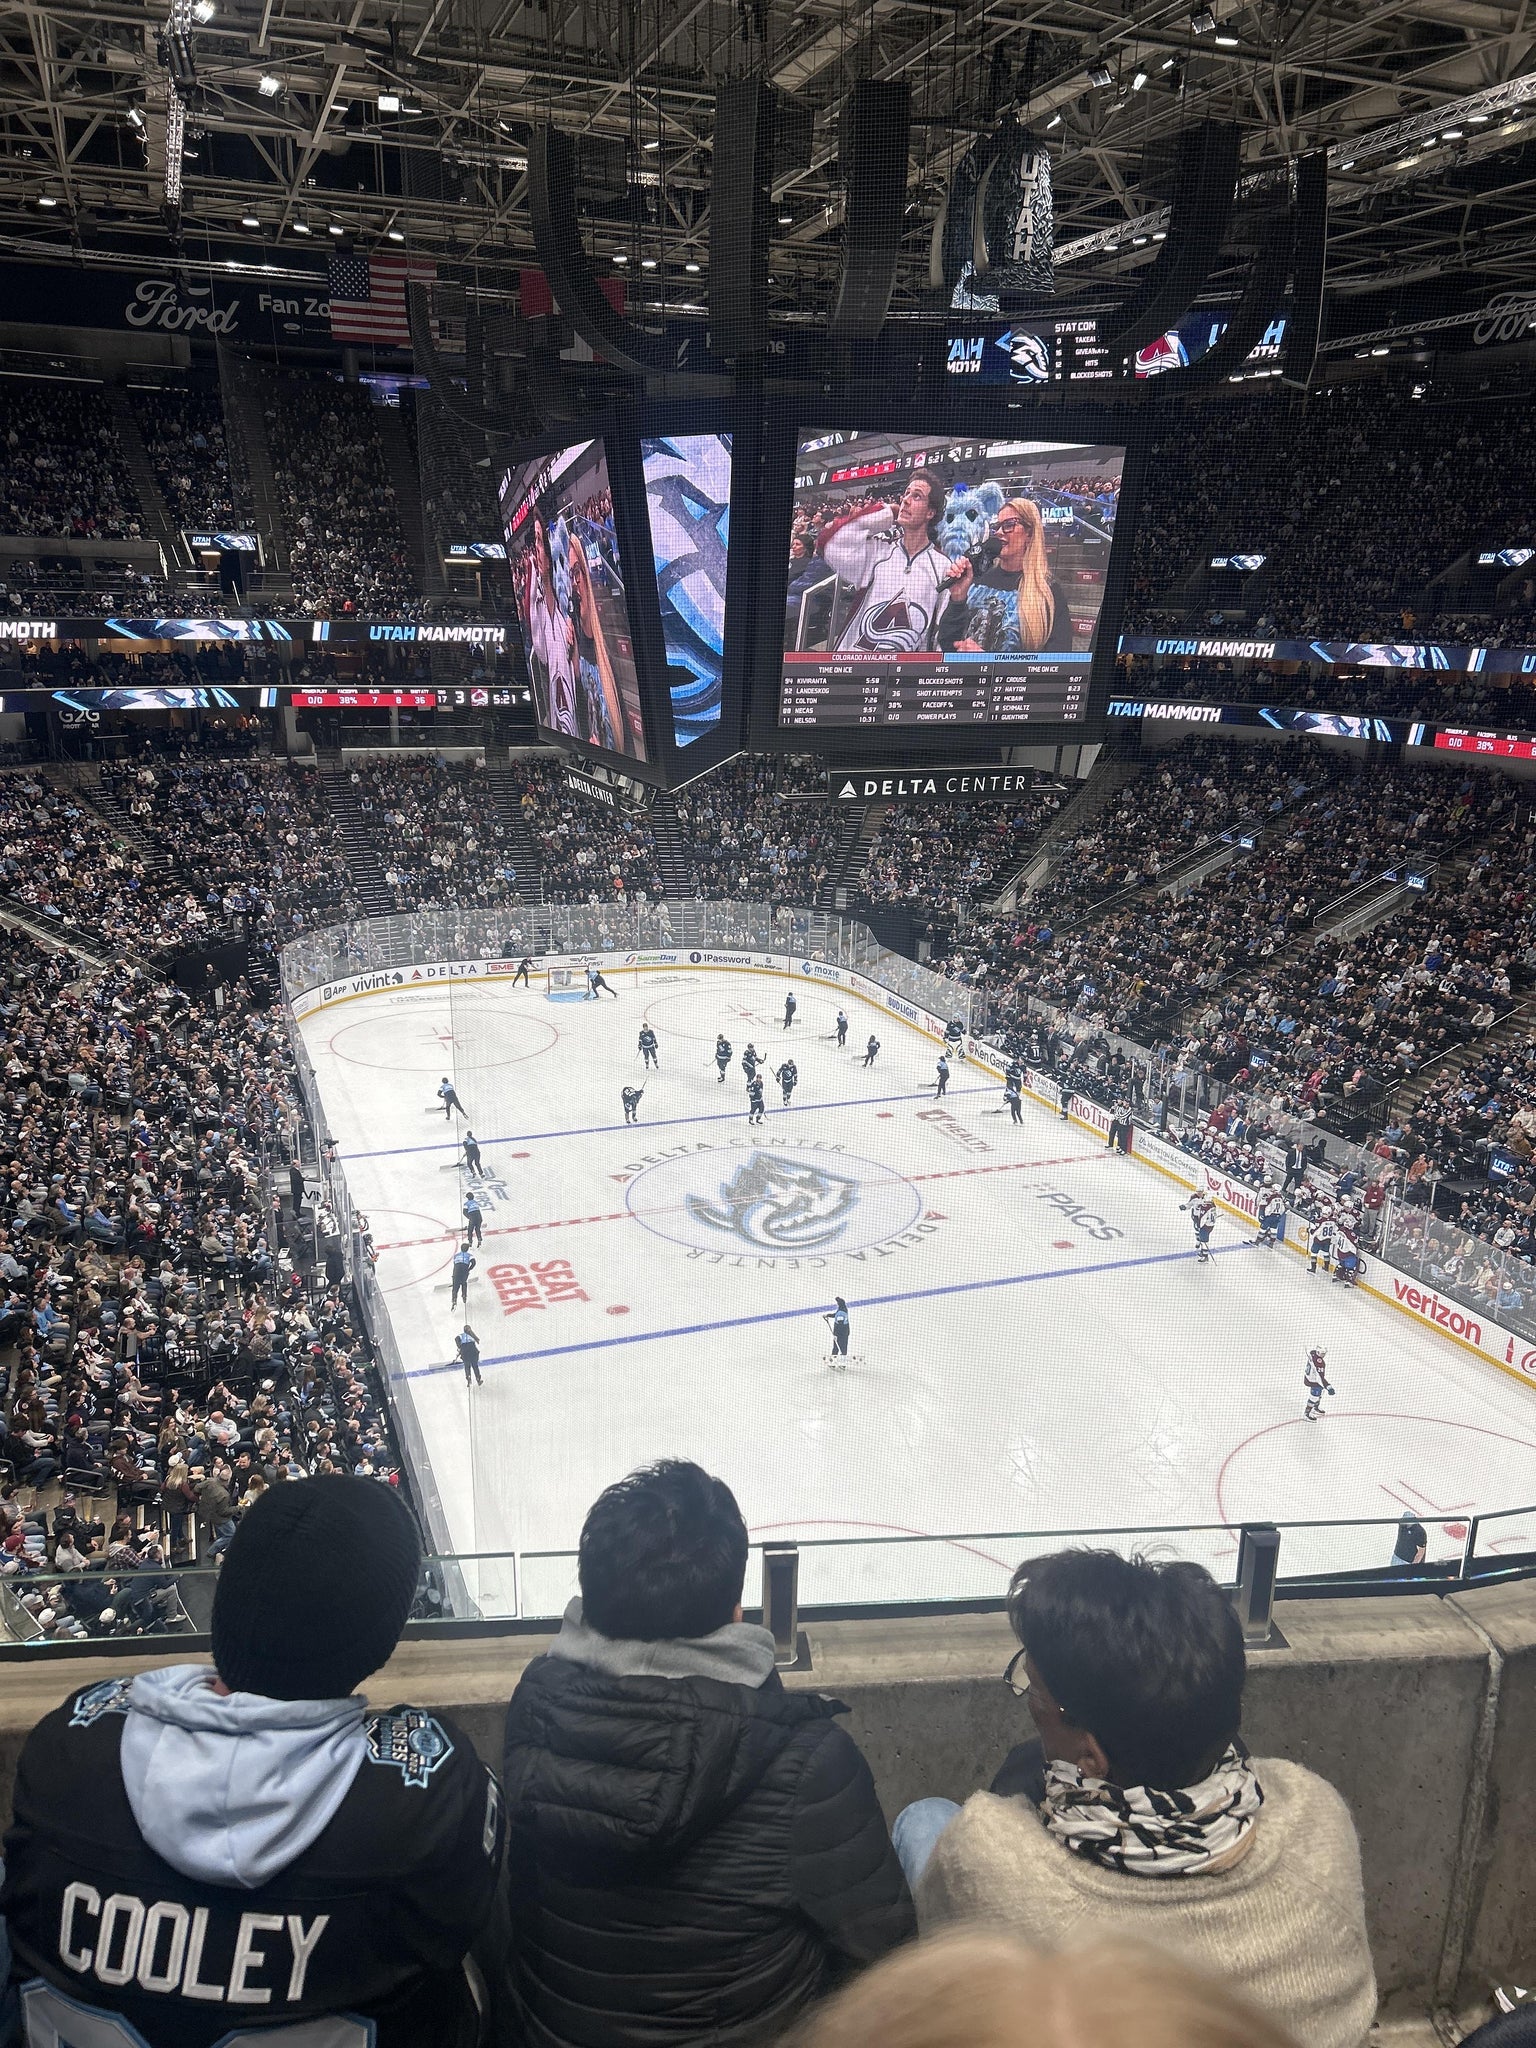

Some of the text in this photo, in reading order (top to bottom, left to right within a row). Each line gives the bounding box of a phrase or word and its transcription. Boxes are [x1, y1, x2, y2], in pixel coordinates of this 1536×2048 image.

[1013, 153, 1041, 261] UTAH
[125, 280, 240, 333] Ford
[259, 294, 299, 316] Fan
[1055, 322, 1075, 333] STAT
[0, 622, 56, 638] MOTH
[370, 626, 506, 642] UTAH MAMMOTH
[1156, 640, 1275, 658] UTAH MAMMOTH
[1521, 655, 1536, 673] U
[339, 695, 358, 704] 38%
[372, 696, 377, 704] 7
[415, 696, 425, 704] 36
[437, 695, 448, 703] 17
[455, 691, 465, 704] 3
[493, 694, 516, 704] 5:21
[1143, 703, 1221, 722] MAMMOTH
[1448, 737, 1462, 748] 0/0
[1477, 740, 1494, 751] 38%
[1508, 744, 1514, 754] 7
[573, 776, 615, 807] DELTA CENTER
[864, 775, 1026, 796] DELTA CENTER
[490, 963, 515, 972] SME
[703, 953, 751, 965] 1Password
[427, 965, 478, 977] DELTA
[814, 966, 840, 979] moxie
[352, 972, 391, 993] vivint
[888, 996, 918, 1021] BUD LIGHT
[974, 1042, 989, 1061] Ken
[1071, 1094, 1112, 1132] RioTin
[624, 1136, 847, 1173] DELTA CENTER
[1036, 1192, 1124, 1241] PACS
[1322, 1226, 1333, 1237] 88
[685, 1223, 938, 1269] DELTA CENTER
[486, 1263, 547, 1317] GEEK
[529, 1259, 592, 1303] SEAT
[1394, 1278, 1482, 1346] verizon
[392, 1719, 409, 1762] SEASON
[59, 1881, 330, 2004] COOLEY
